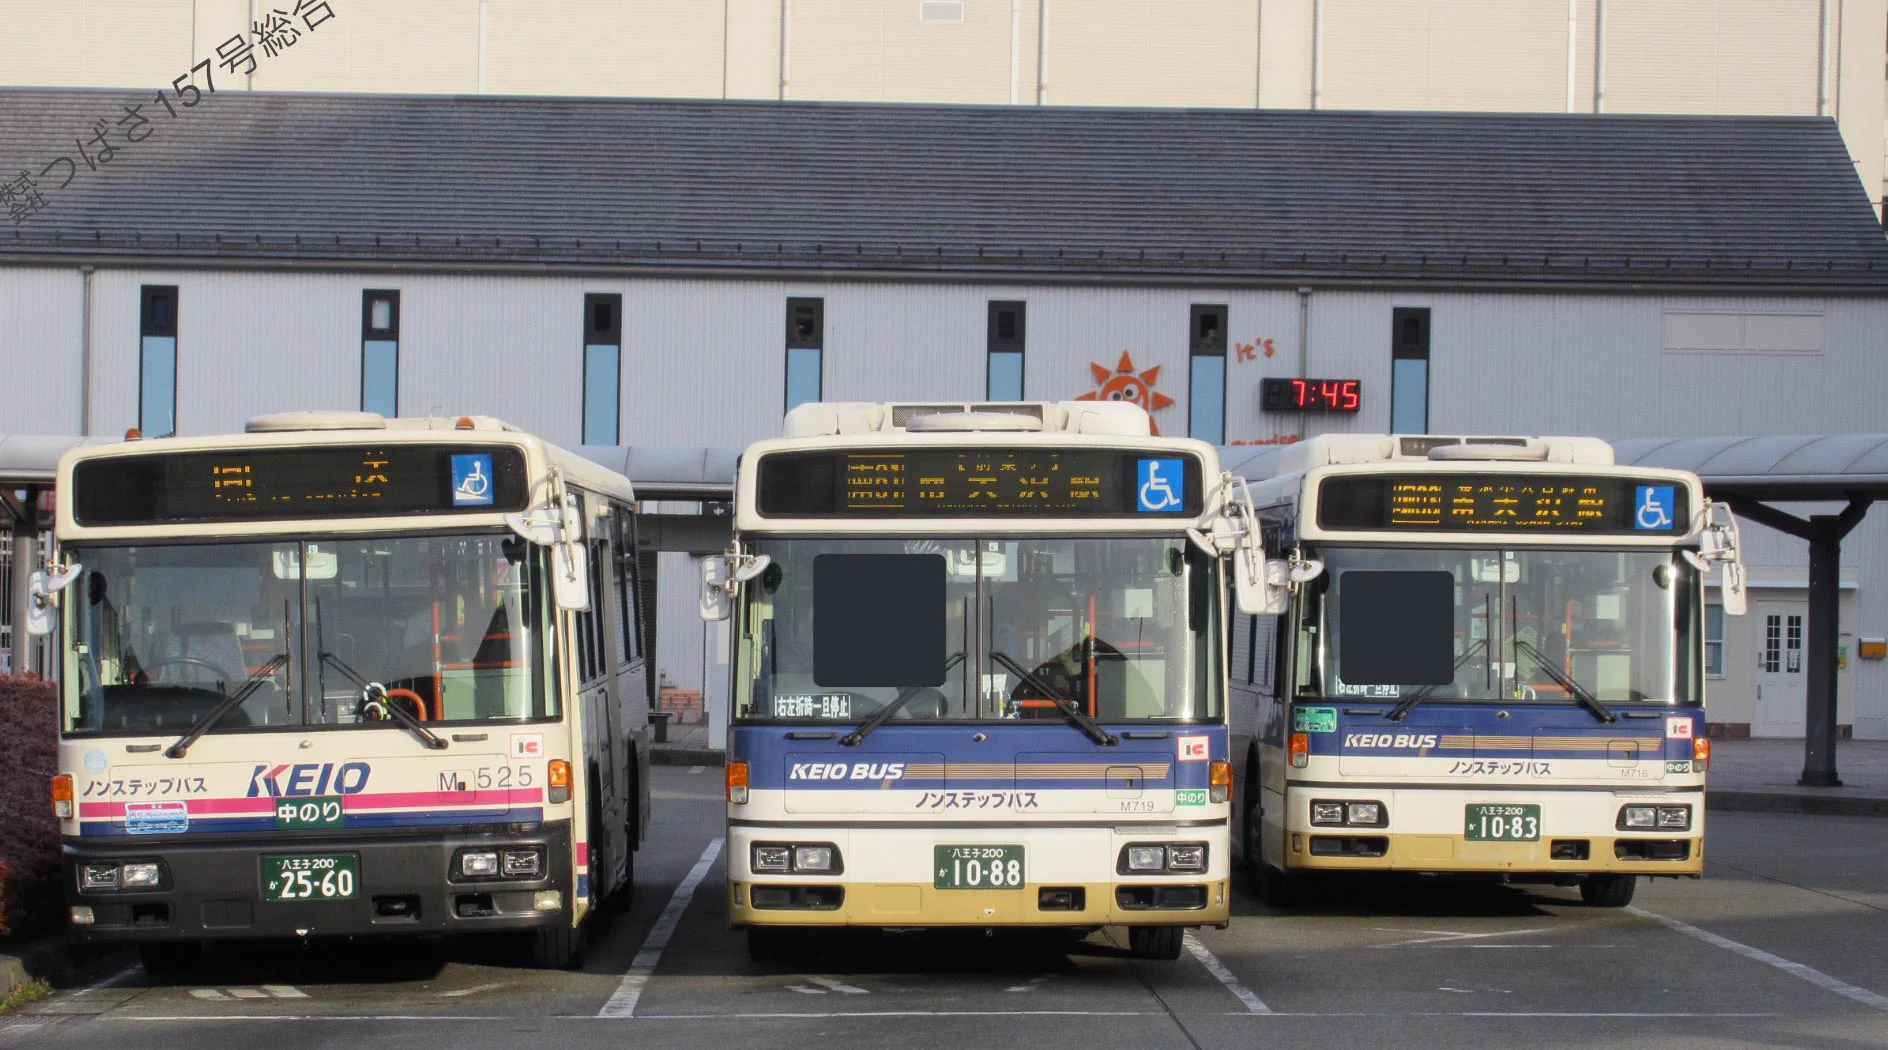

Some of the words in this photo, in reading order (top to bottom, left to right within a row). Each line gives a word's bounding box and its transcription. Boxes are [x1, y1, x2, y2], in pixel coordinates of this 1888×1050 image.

[1235, 338, 1277, 364] It's
[1291, 379, 1360, 410] 7:45
[777, 695, 849, 719] 右左折時一旦停止
[1344, 733, 1393, 749] KEIO
[1393, 733, 1438, 749] BUS
[245, 761, 371, 799] KEIO
[789, 763, 848, 781] KEIO
[850, 763, 905, 781] BUS
[1448, 760, 1552, 776] ノンステップバス
[82, 776, 208, 797] ノンステップバス
[1176, 792, 1205, 804] 中のり
[277, 800, 342, 824] 中のり
[914, 791, 1039, 810] ノンステップバス
[1120, 800, 1154, 812] M719
[1479, 816, 1538, 840] 10-83
[280, 870, 354, 899] 25-60
[953, 859, 1021, 887] 10-88
